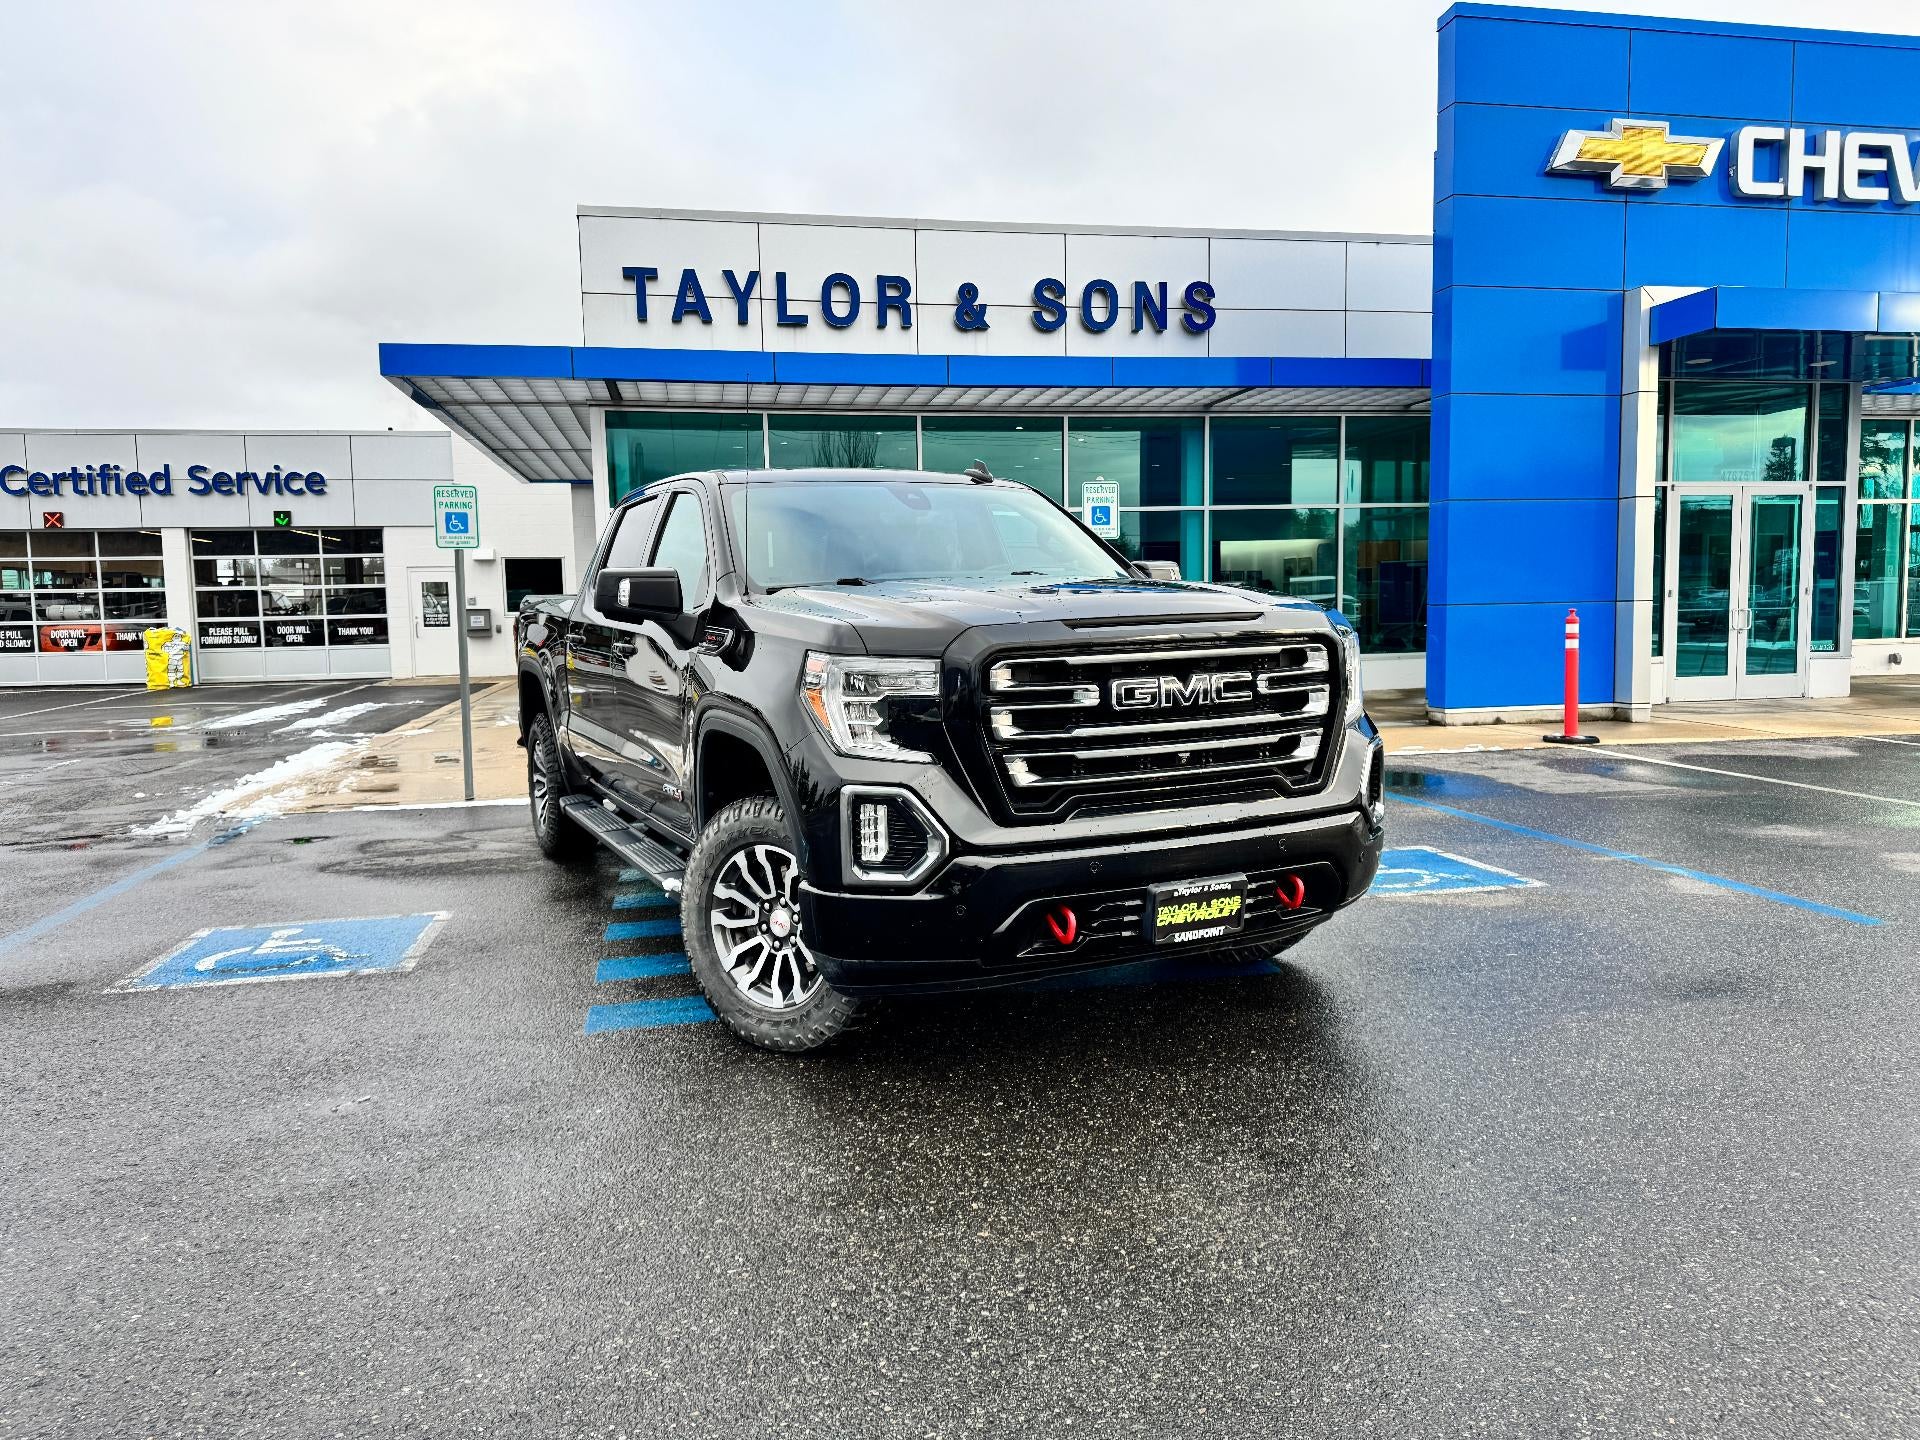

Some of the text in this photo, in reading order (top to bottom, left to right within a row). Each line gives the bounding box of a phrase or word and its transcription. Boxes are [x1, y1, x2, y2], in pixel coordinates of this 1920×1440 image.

[1732, 126, 1920, 203] CHEV
[622, 266, 1217, 333] TAYLOR & SONS
[0, 463, 328, 496] Certified Service
[436, 489, 474, 498] RESERVED
[1085, 486, 1116, 494] RESERVED
[1086, 496, 1115, 504] PARKING
[438, 501, 473, 510] PARKING
[6, 631, 23, 639] PULL
[50, 629, 87, 639] DOOR WILL
[208, 627, 250, 636] PLEASE PULL
[276, 625, 311, 635] DOOR WILL
[337, 626, 374, 636] THANK YOU!
[115, 632, 138, 641] THANK
[200, 635, 258, 645] FORWARD SLOWLY
[285, 634, 303, 643] OPEN
[5, 639, 32, 648] SLOWLY
[60, 639, 78, 647] OPEN
[1111, 672, 1253, 711] GMC
[1157, 902, 1198, 915] TAYLOR
[1210, 895, 1242, 908] SONS
[1156, 905, 1242, 927] CHEVROLET
[1173, 925, 1226, 943] SANDPOINT
